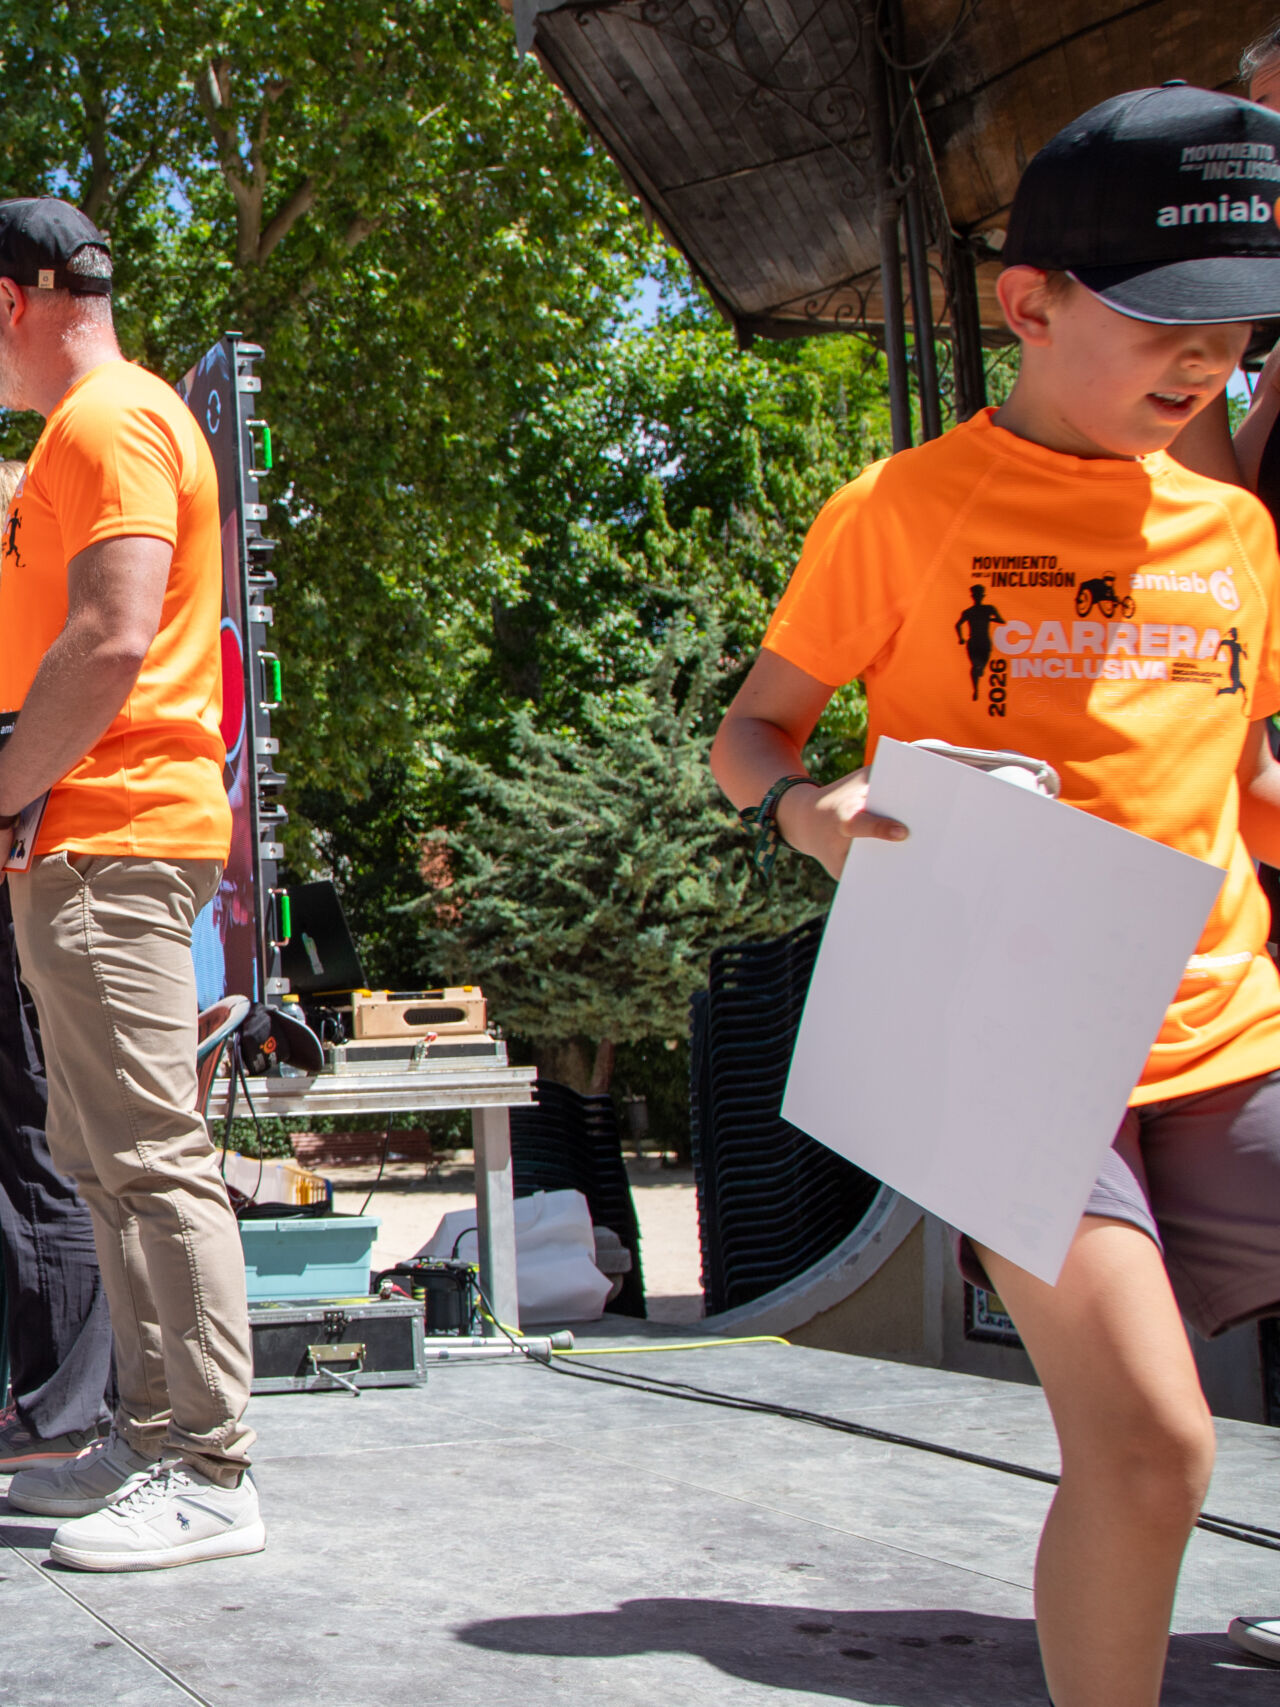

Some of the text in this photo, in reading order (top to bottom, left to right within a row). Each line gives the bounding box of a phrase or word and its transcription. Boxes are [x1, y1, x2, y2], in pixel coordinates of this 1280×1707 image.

[1181, 142, 1275, 163] MOVIMIENTO
[1157, 194, 1271, 227] amiab
[972, 555, 1057, 570] MOVIMIENTO
[991, 568, 1076, 588] INCLUSIÓN
[1131, 569, 1208, 593] amiab
[993, 620, 1227, 662] CARRERA
[1010, 658, 1169, 680] INCLUSIVA
[988, 658, 1007, 717] 2026
[0, 722, 15, 734] ami
